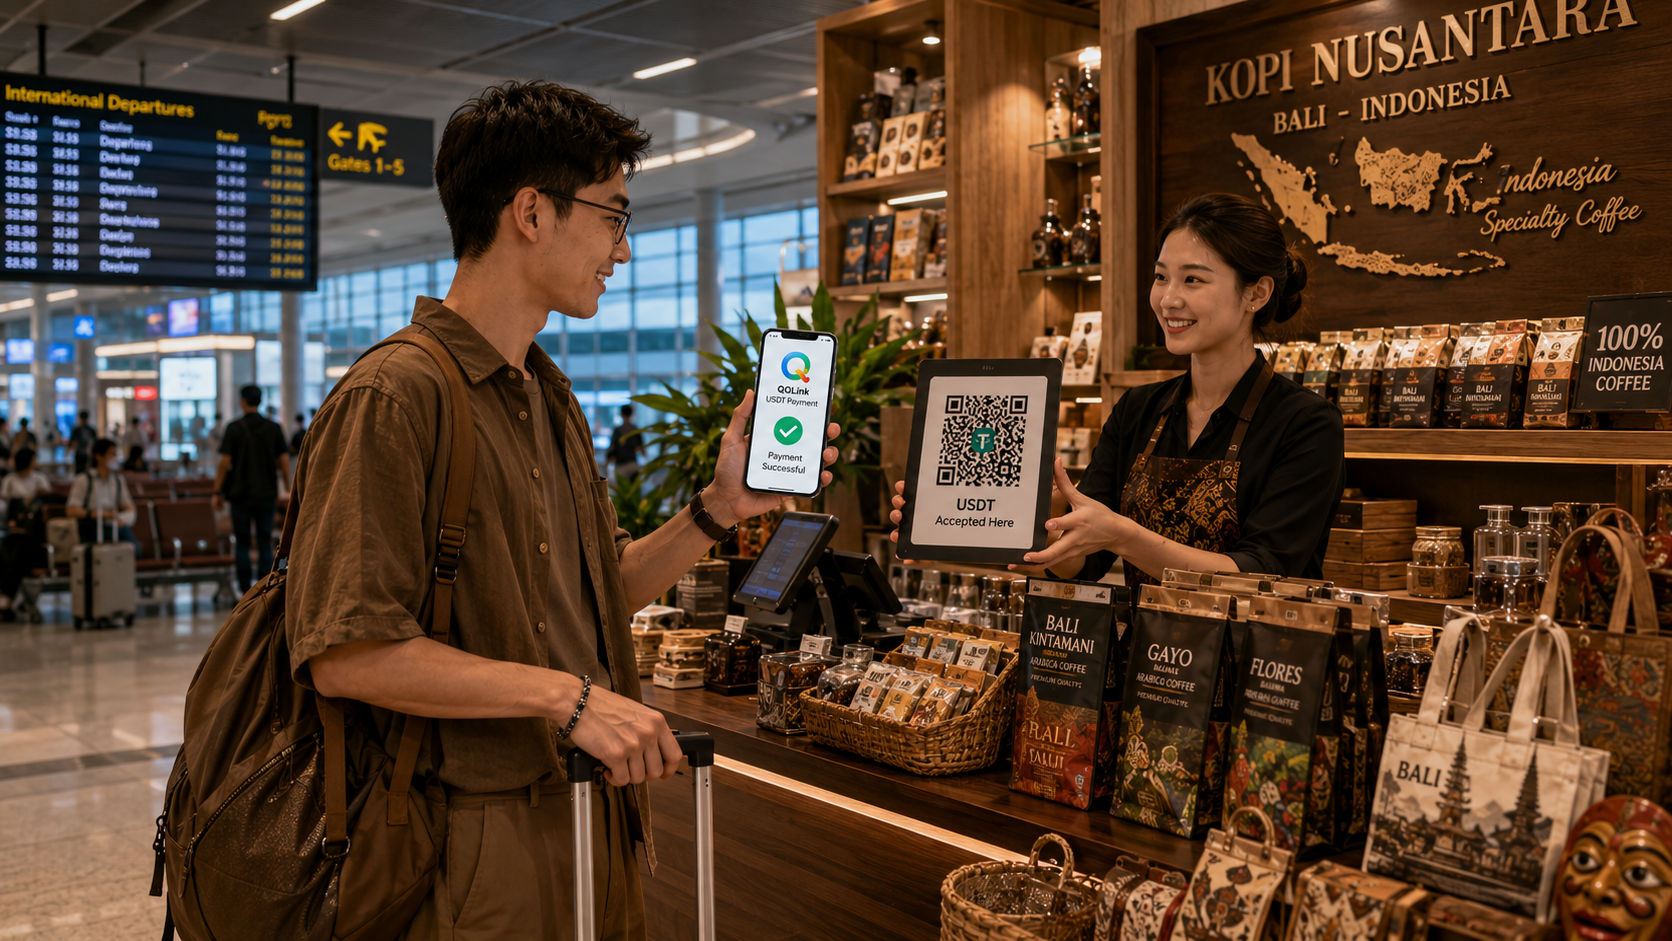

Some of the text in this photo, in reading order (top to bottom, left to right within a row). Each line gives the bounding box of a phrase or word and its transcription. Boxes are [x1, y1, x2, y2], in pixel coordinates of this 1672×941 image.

[1205, 0, 1637, 106] KOPI NUSANTARA
[5, 84, 195, 118] International Departures
[1273, 104, 1326, 134] BALI
[1360, 74, 1511, 121] INDONESIA
[327, 153, 405, 176] Gates 1-5
[1480, 196, 1642, 242] Specialty Coffee
[1597, 322, 1663, 351] 100%
[1588, 355, 1664, 372] INDONESIA
[1595, 375, 1652, 391] COFFEE
[765, 395, 818, 407] USDT Payment
[768, 451, 803, 462] Payment
[761, 462, 806, 474] Successful
[956, 498, 996, 511] USDT
[935, 515, 1014, 528] Accepted Here
[1045, 614, 1080, 634] BALI
[1029, 631, 1095, 654] KINTAMANI
[1147, 643, 1193, 667] GAYO
[1059, 661, 1087, 674] COFFEE
[1249, 657, 1303, 685] FLORES
[1166, 678, 1196, 692] COFFEE
[1396, 760, 1441, 788] BALI
